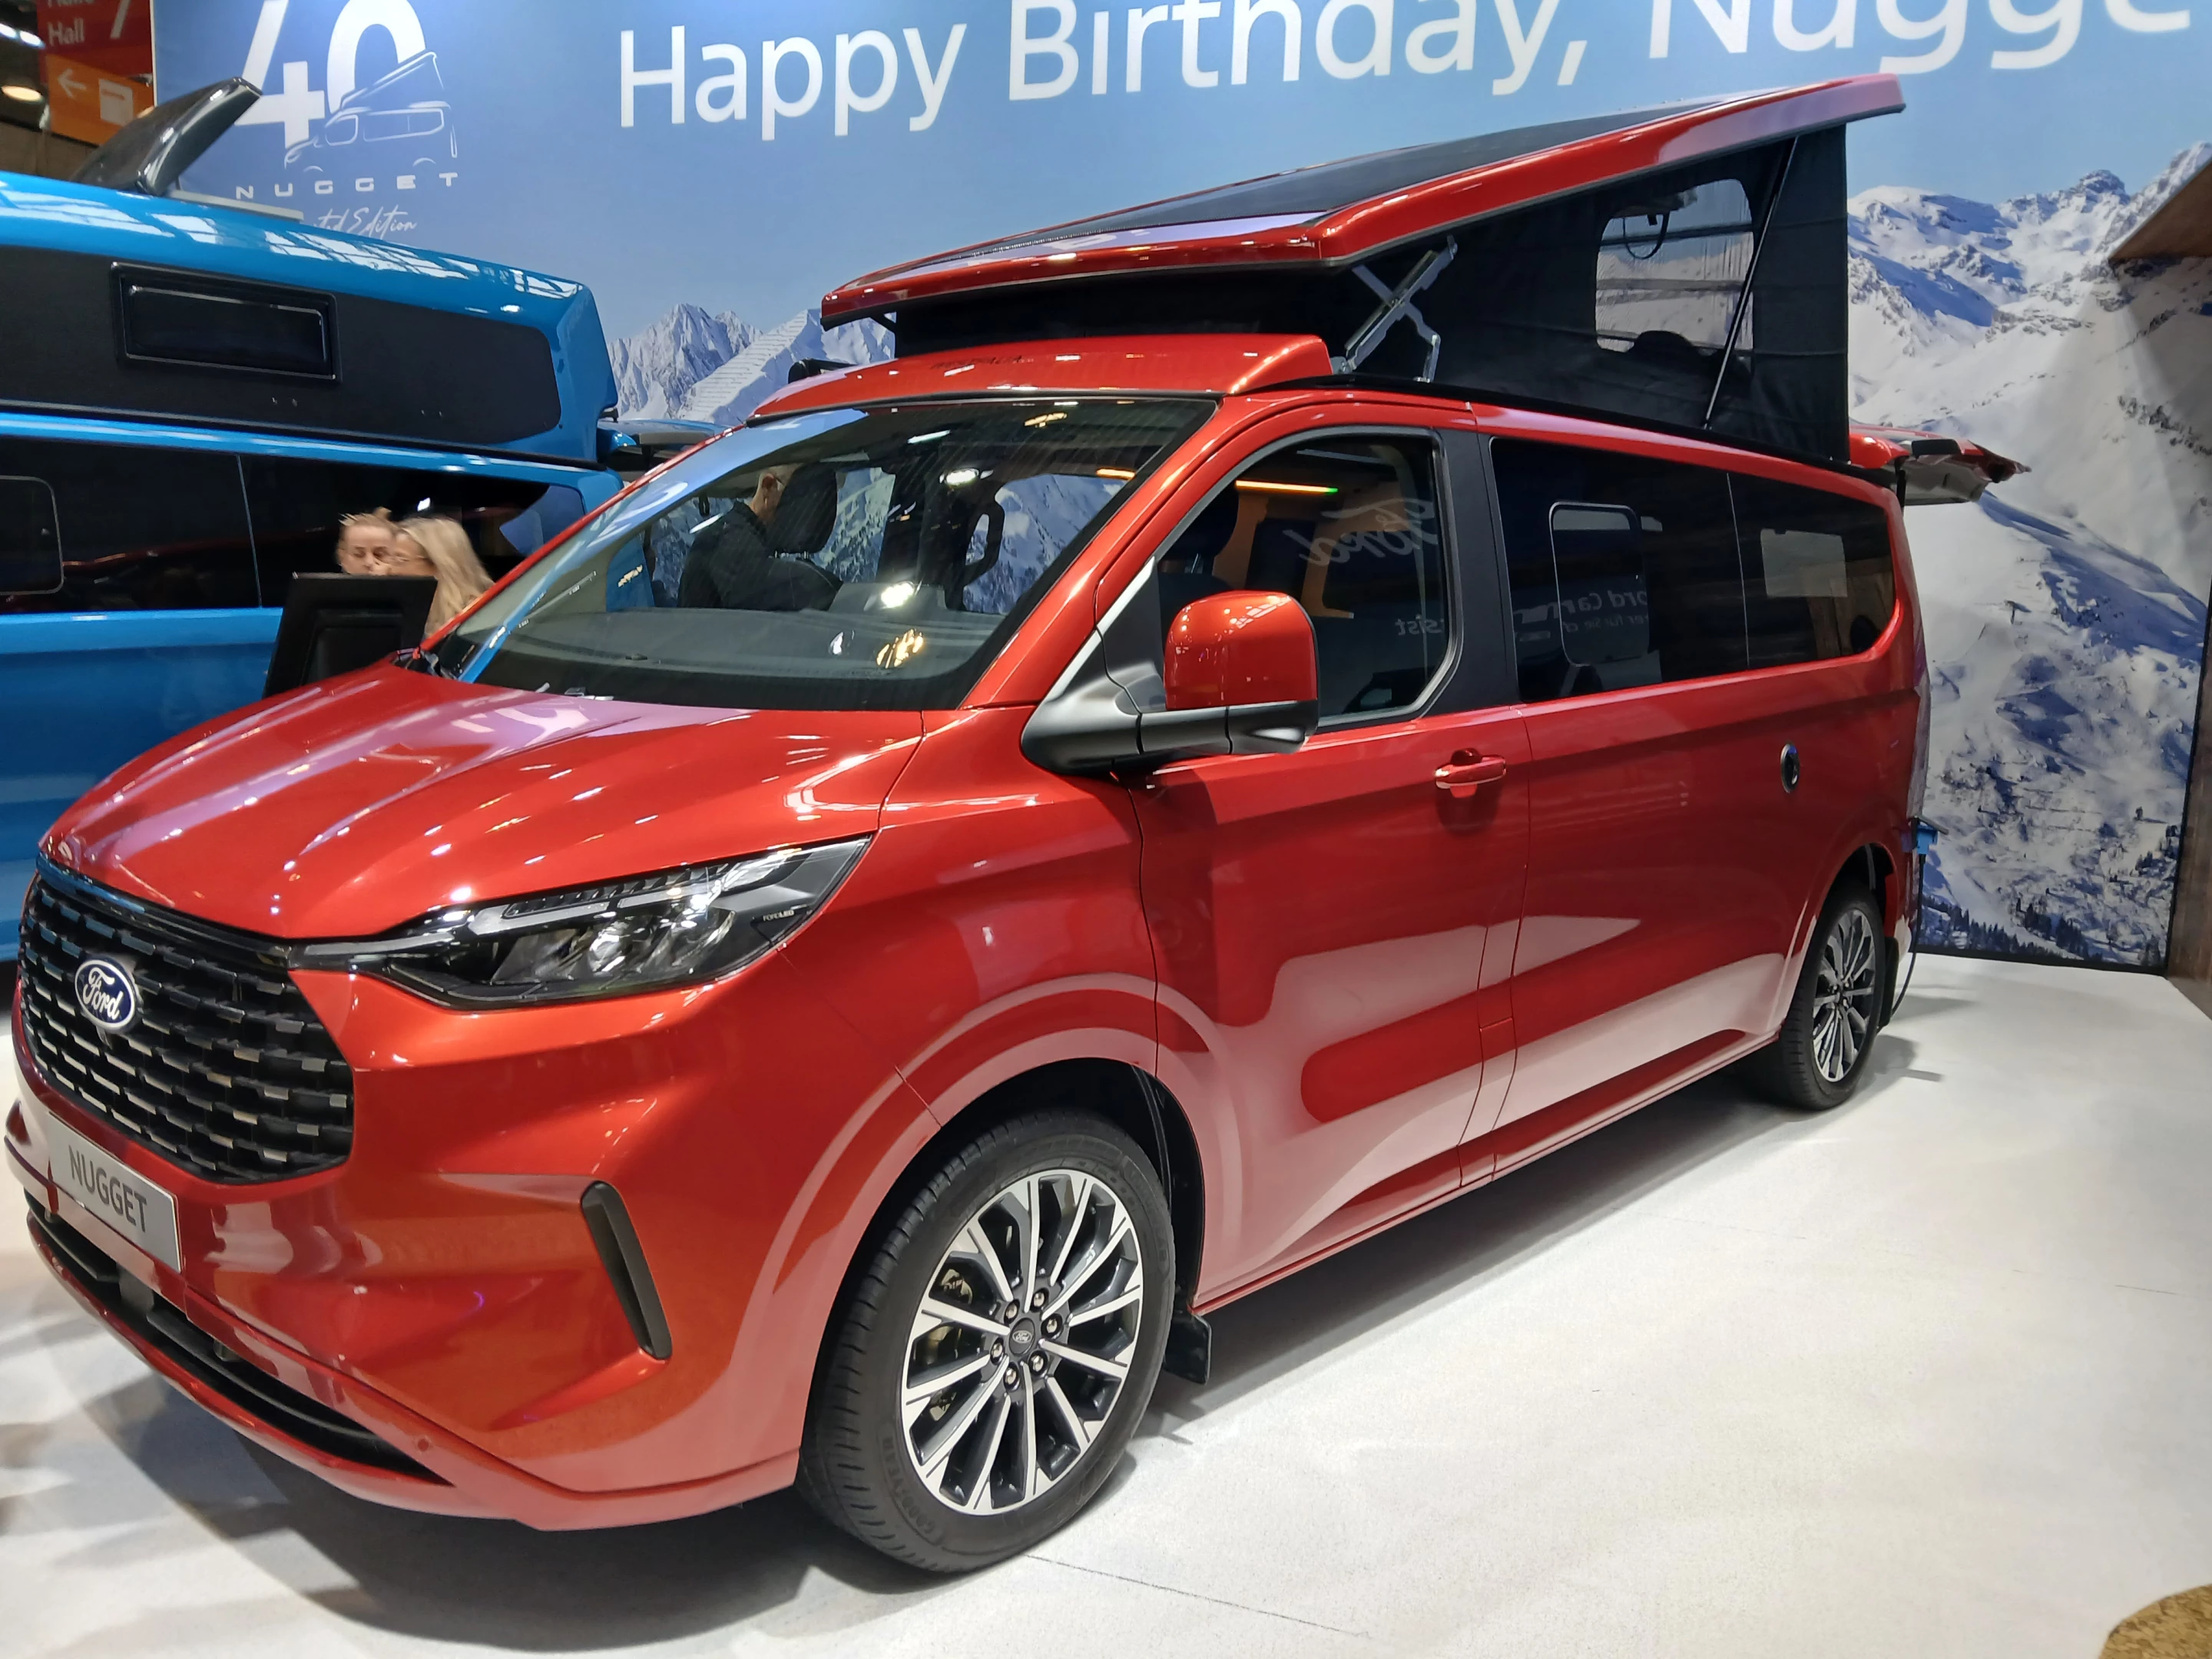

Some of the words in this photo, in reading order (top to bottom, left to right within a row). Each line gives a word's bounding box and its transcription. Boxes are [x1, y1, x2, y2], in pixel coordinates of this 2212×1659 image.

[48, 18, 84, 46] Hall
[620, 24, 967, 141] Happy
[1009, 0, 1588, 101] Birthday,
[236, 172, 459, 200] NUGGET
[346, 204, 418, 240] Edition
[82, 967, 123, 1020] Ford
[68, 1144, 147, 1233] NUGGET
